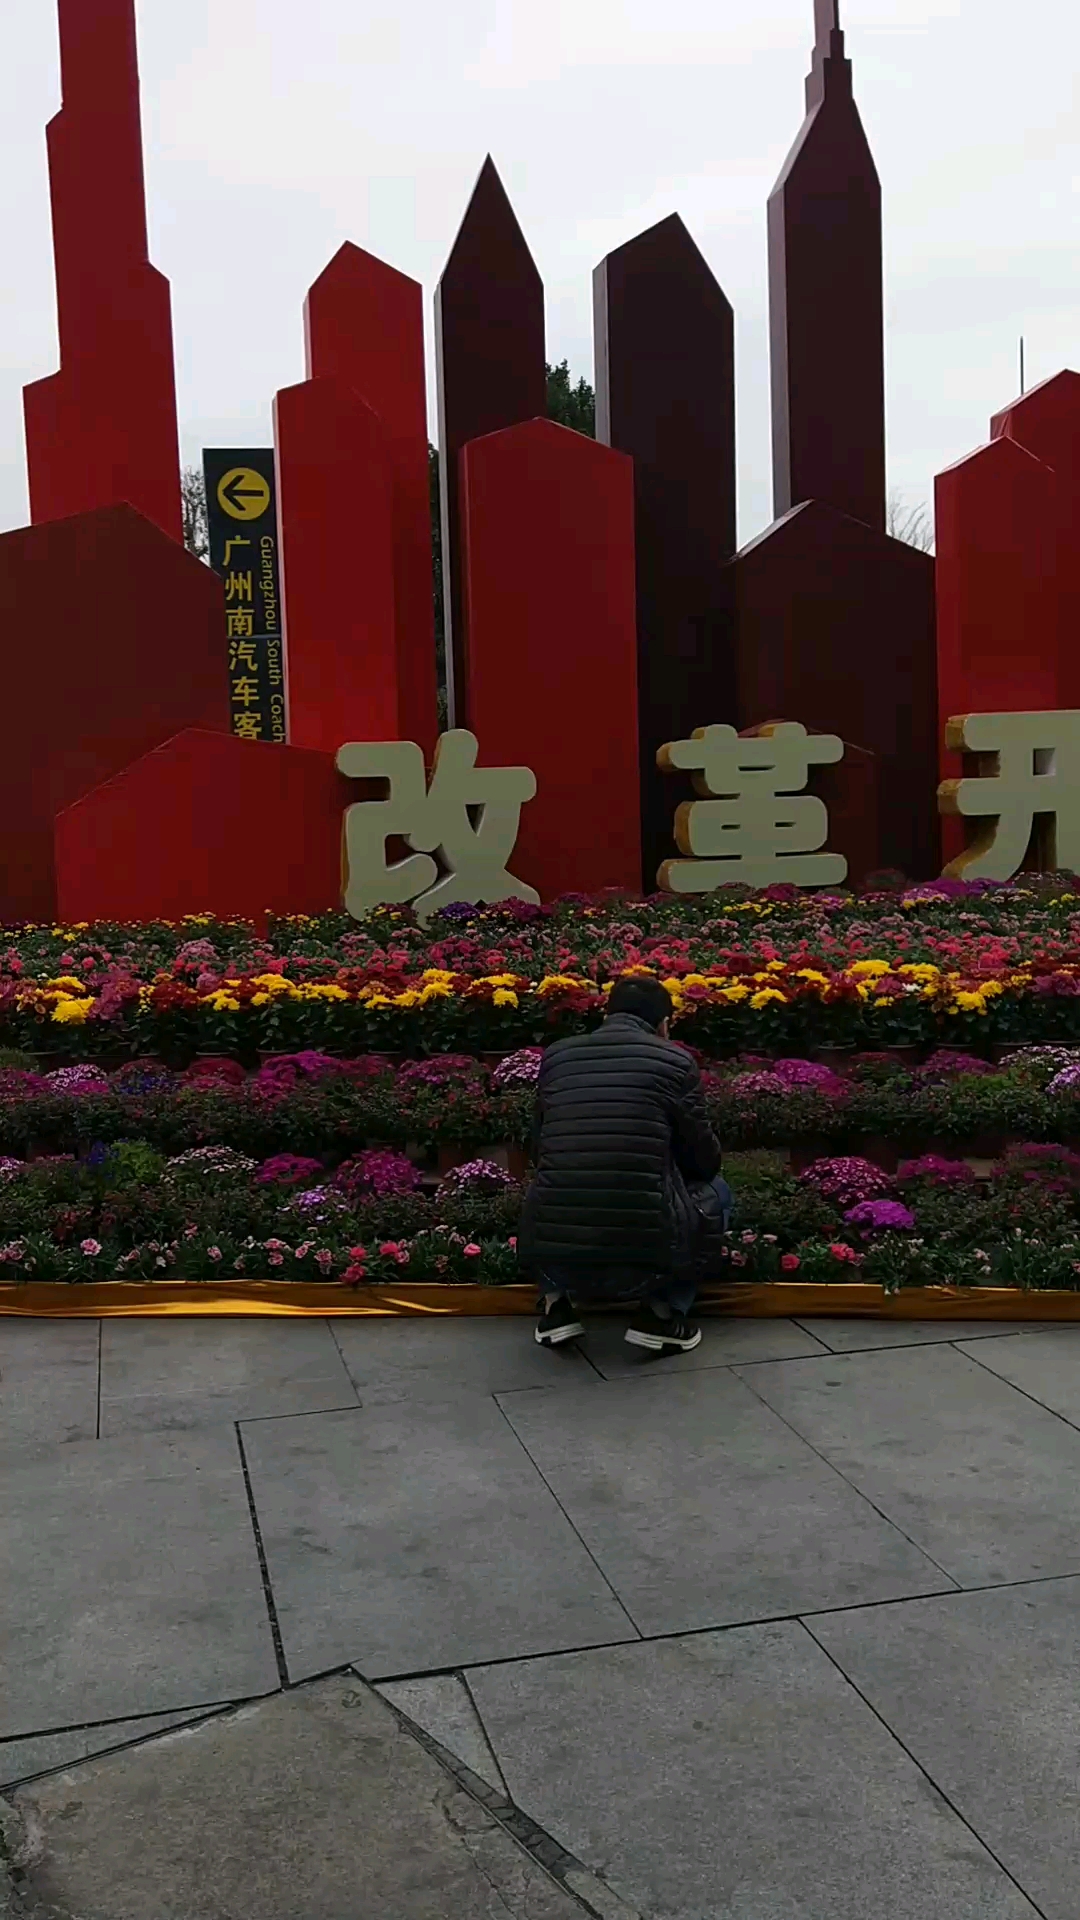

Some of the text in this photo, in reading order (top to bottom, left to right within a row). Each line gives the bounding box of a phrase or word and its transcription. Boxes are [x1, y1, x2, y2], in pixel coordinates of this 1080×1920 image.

[222, 534, 262, 741] 广州南汽车客
[259, 535, 286, 742] Guangzhou South Coach
